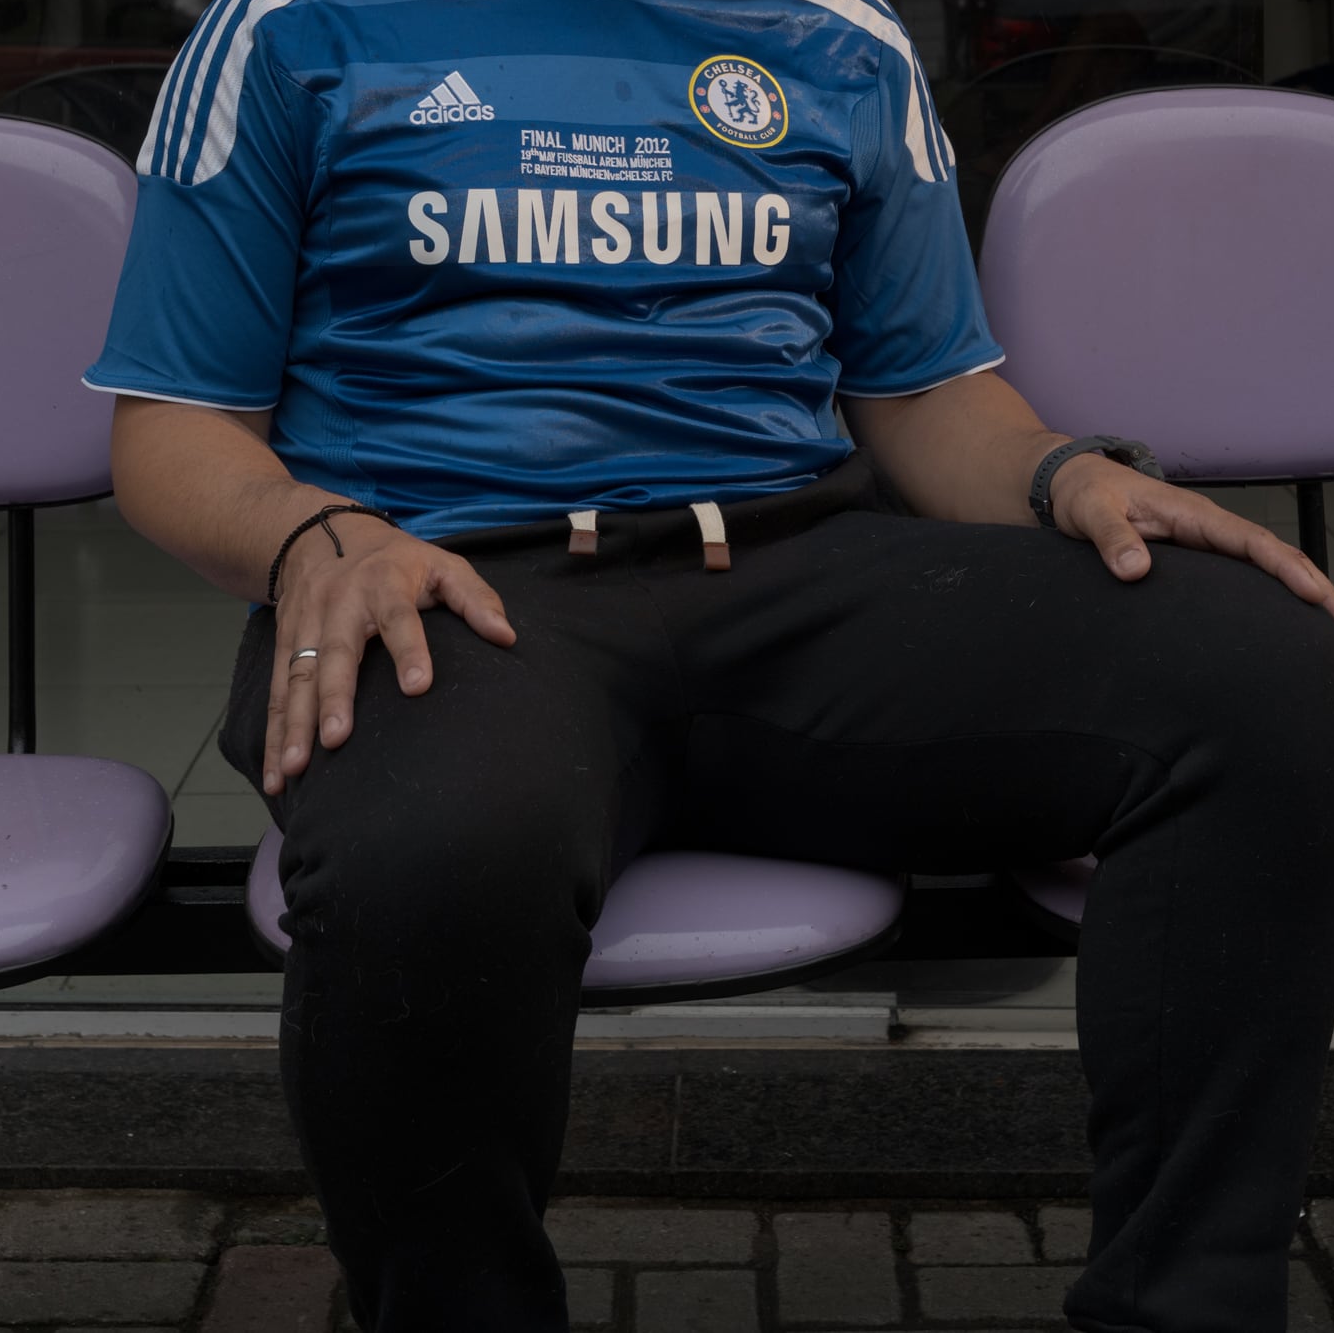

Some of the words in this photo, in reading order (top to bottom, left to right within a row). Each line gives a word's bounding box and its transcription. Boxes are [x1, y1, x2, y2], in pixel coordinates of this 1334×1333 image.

[704, 62, 762, 84] CHELSEA
[409, 104, 495, 126] adidas
[521, 129, 566, 149] FINAL
[571, 133, 625, 154] MUNICH
[634, 137, 671, 155] 2012
[716, 122, 759, 141] FOOTBALL
[759, 127, 776, 140] CLUB
[557, 152, 597, 167] FUSSBALL
[599, 156, 629, 168] ARENA
[630, 154, 672, 169] MÜNCHEN
[521, 163, 533, 174] FC
[534, 164, 568, 177] BAYERN
[661, 171, 674, 182] FC
[407, 187, 791, 267] SAMSUNG
